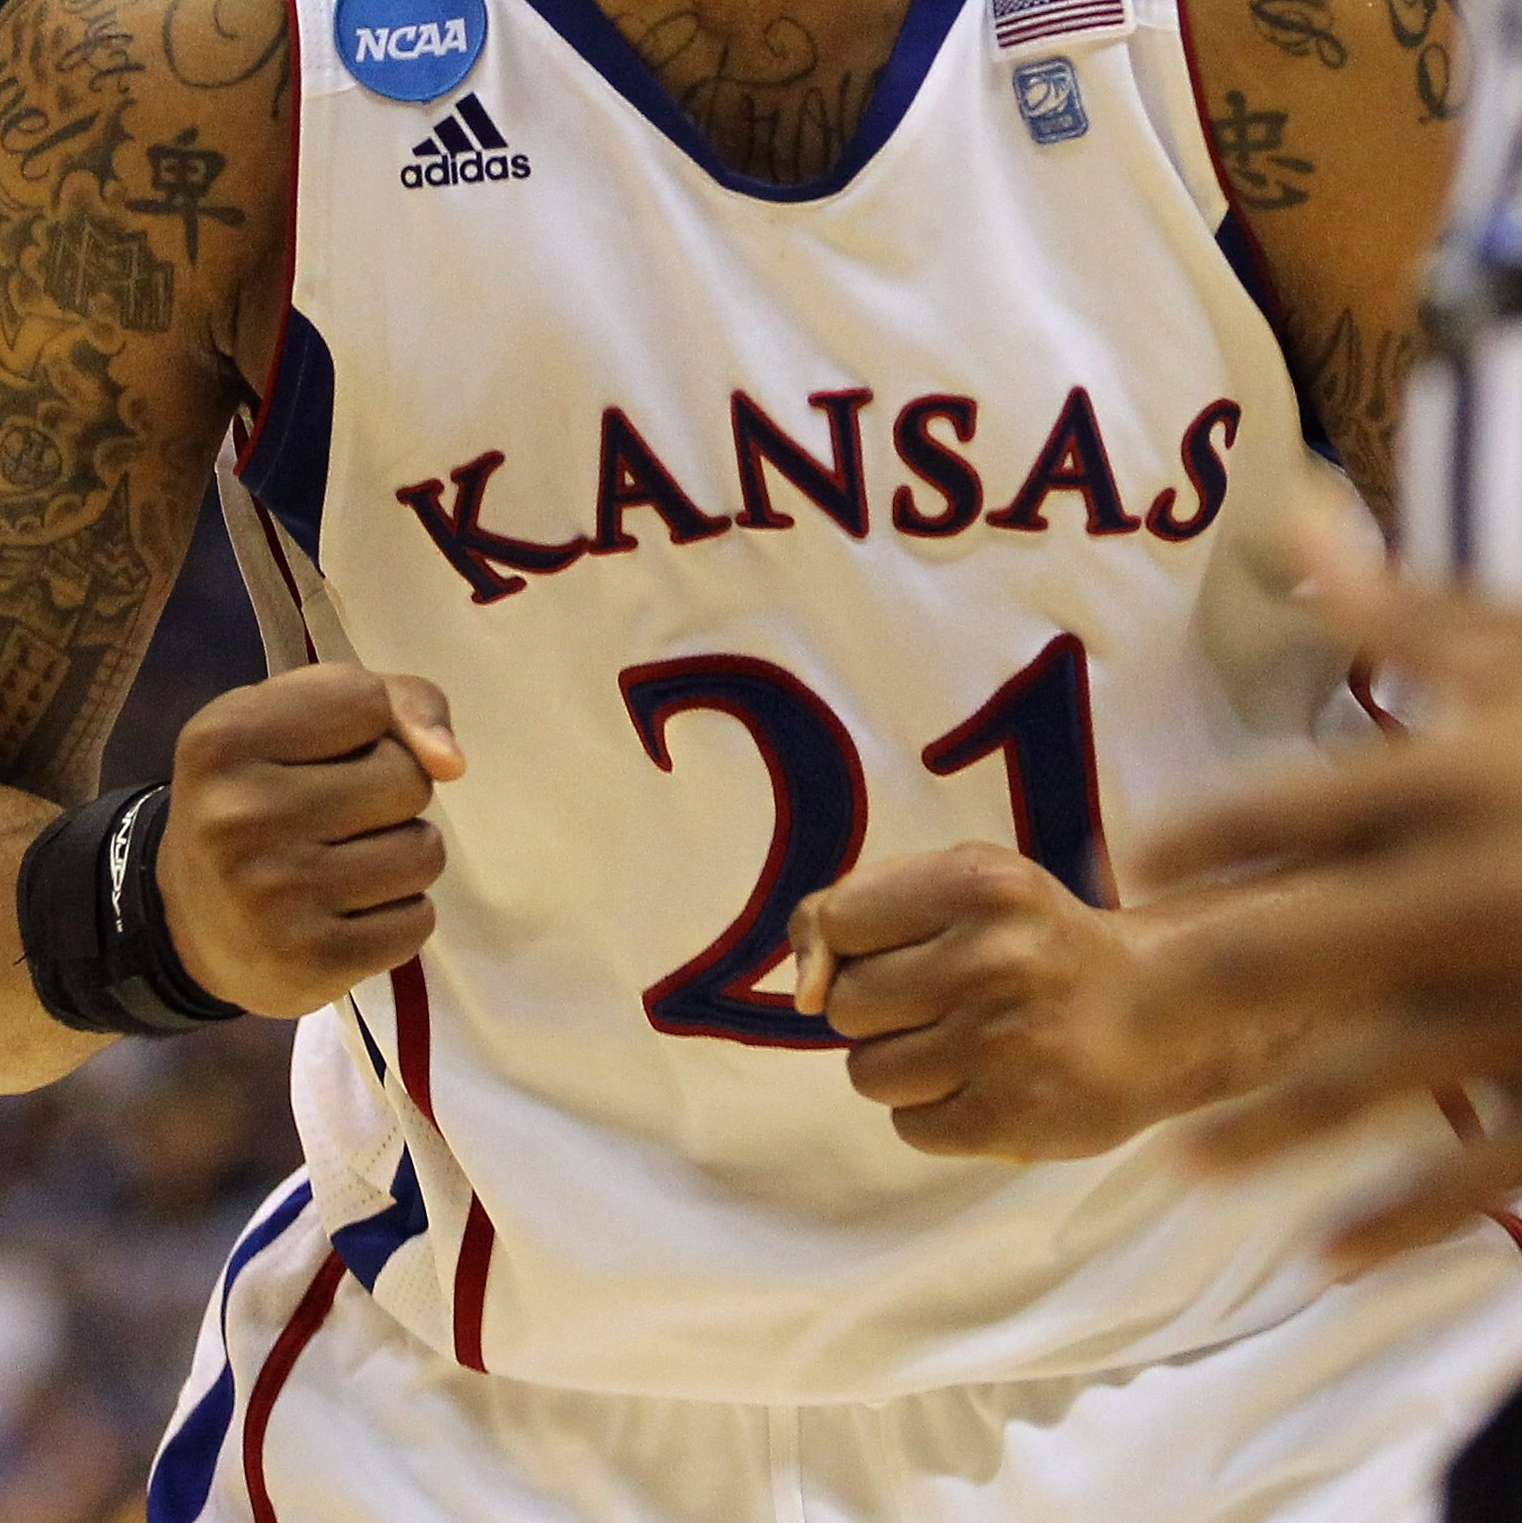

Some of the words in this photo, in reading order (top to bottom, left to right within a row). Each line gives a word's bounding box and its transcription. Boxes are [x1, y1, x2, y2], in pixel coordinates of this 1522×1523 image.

[355, 18, 468, 62] NCAA
[400, 152, 531, 189] adidas
[397, 386, 1241, 605] KANSAS
[619, 633, 1121, 1050] 21
